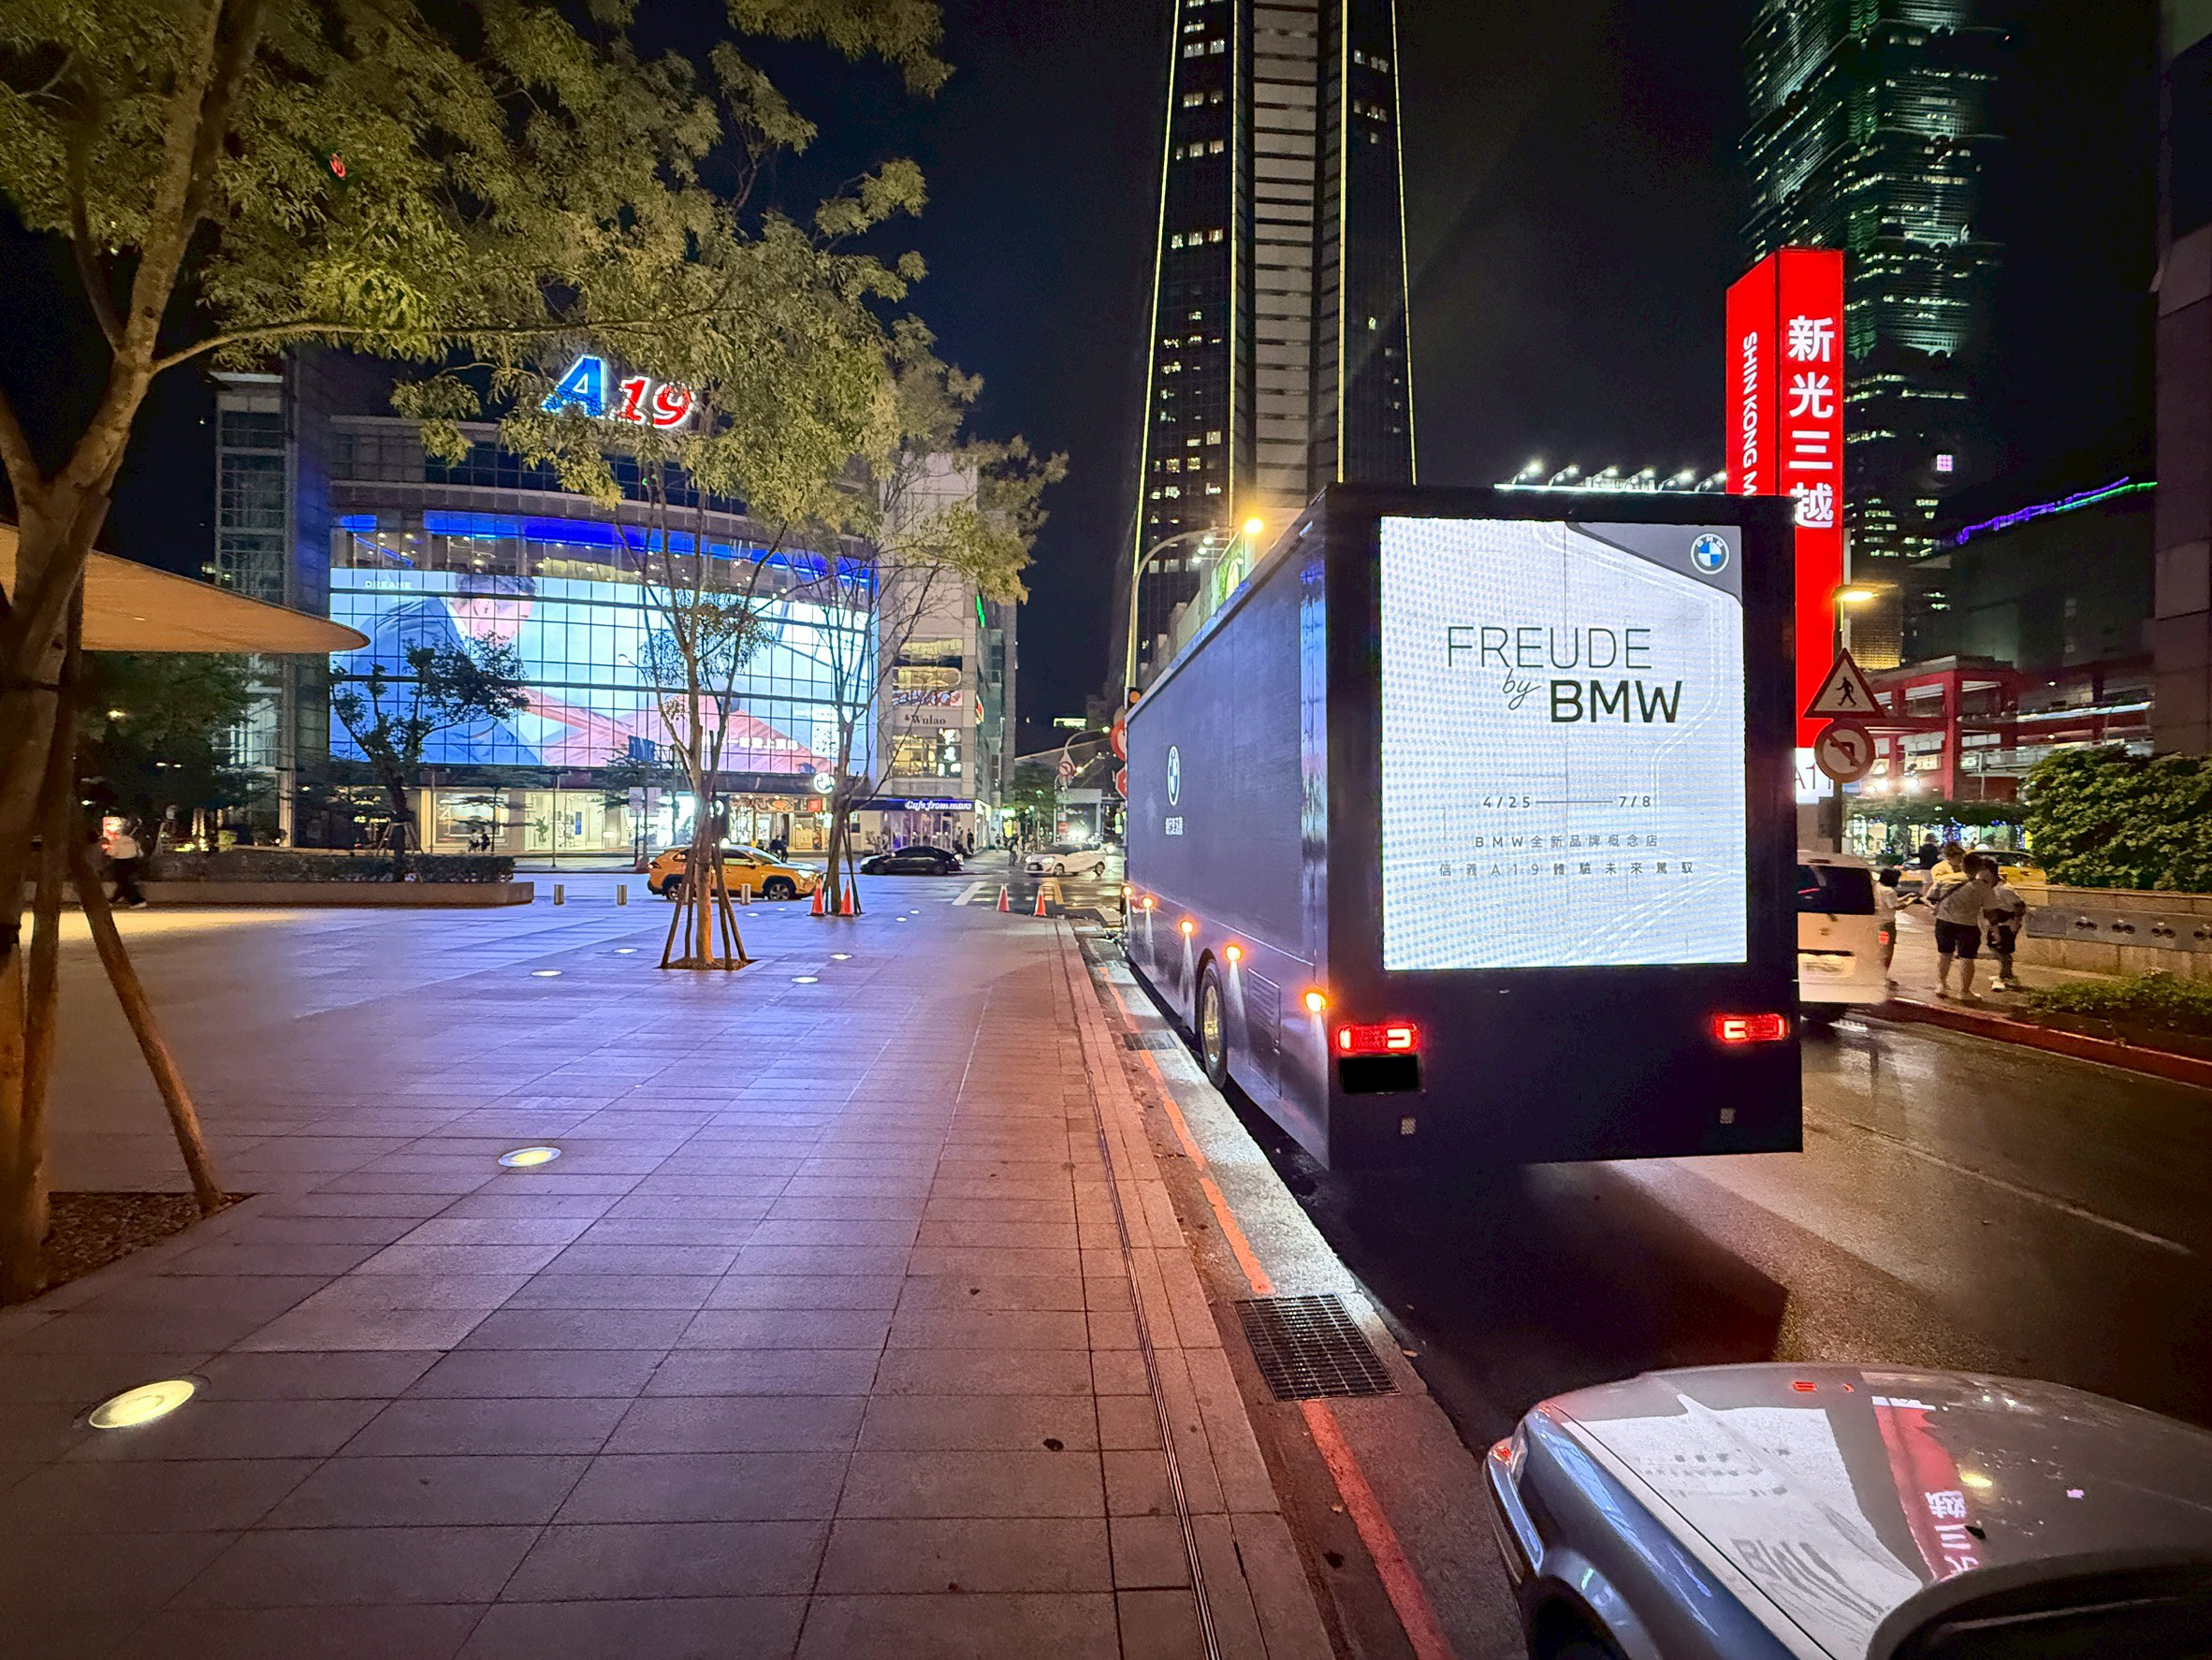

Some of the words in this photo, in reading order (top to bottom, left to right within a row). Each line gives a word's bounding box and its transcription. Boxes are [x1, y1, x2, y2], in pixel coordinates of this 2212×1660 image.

[1742, 330, 1758, 395] SHIN
[1742, 394, 1758, 469] KONG
[1788, 314, 1834, 528] 新光三越
[1447, 626, 1652, 669] FREUDE
[911, 714, 946, 725] Wulao
[1502, 668, 1542, 710] by
[1550, 679, 1682, 723] BMW
[1483, 795, 1531, 808] 4/25
[1618, 795, 1652, 808] 7/8
